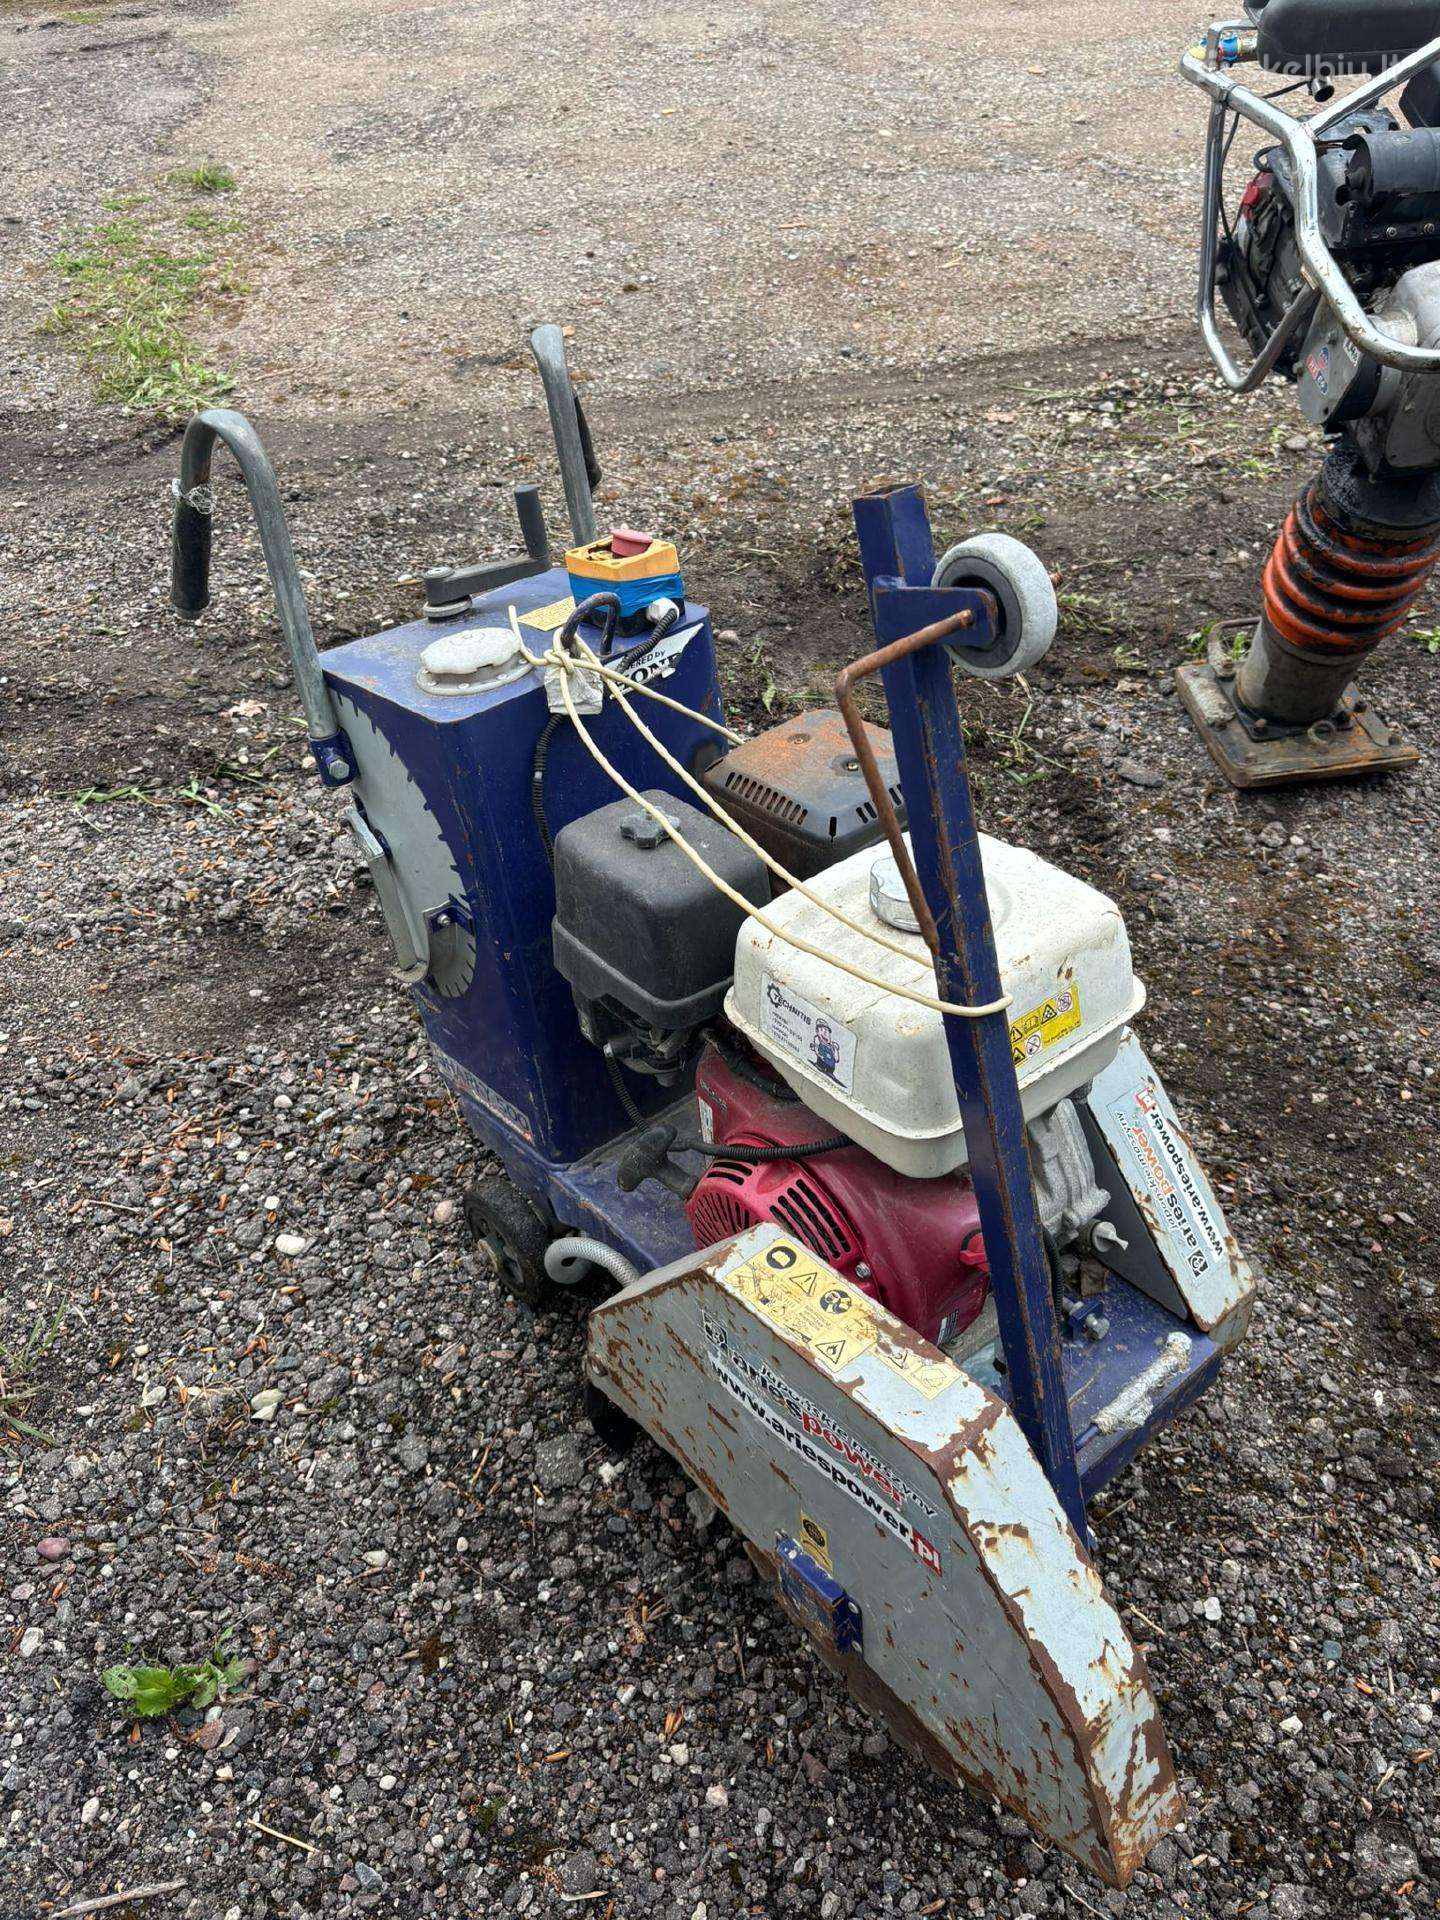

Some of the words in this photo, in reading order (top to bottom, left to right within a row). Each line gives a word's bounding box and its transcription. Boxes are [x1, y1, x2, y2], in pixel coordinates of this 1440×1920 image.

[1132, 1126, 1198, 1248] ariespower
[711, 1360, 941, 1570] www.ariespower.pl
[732, 1352, 907, 1505] ariespower
